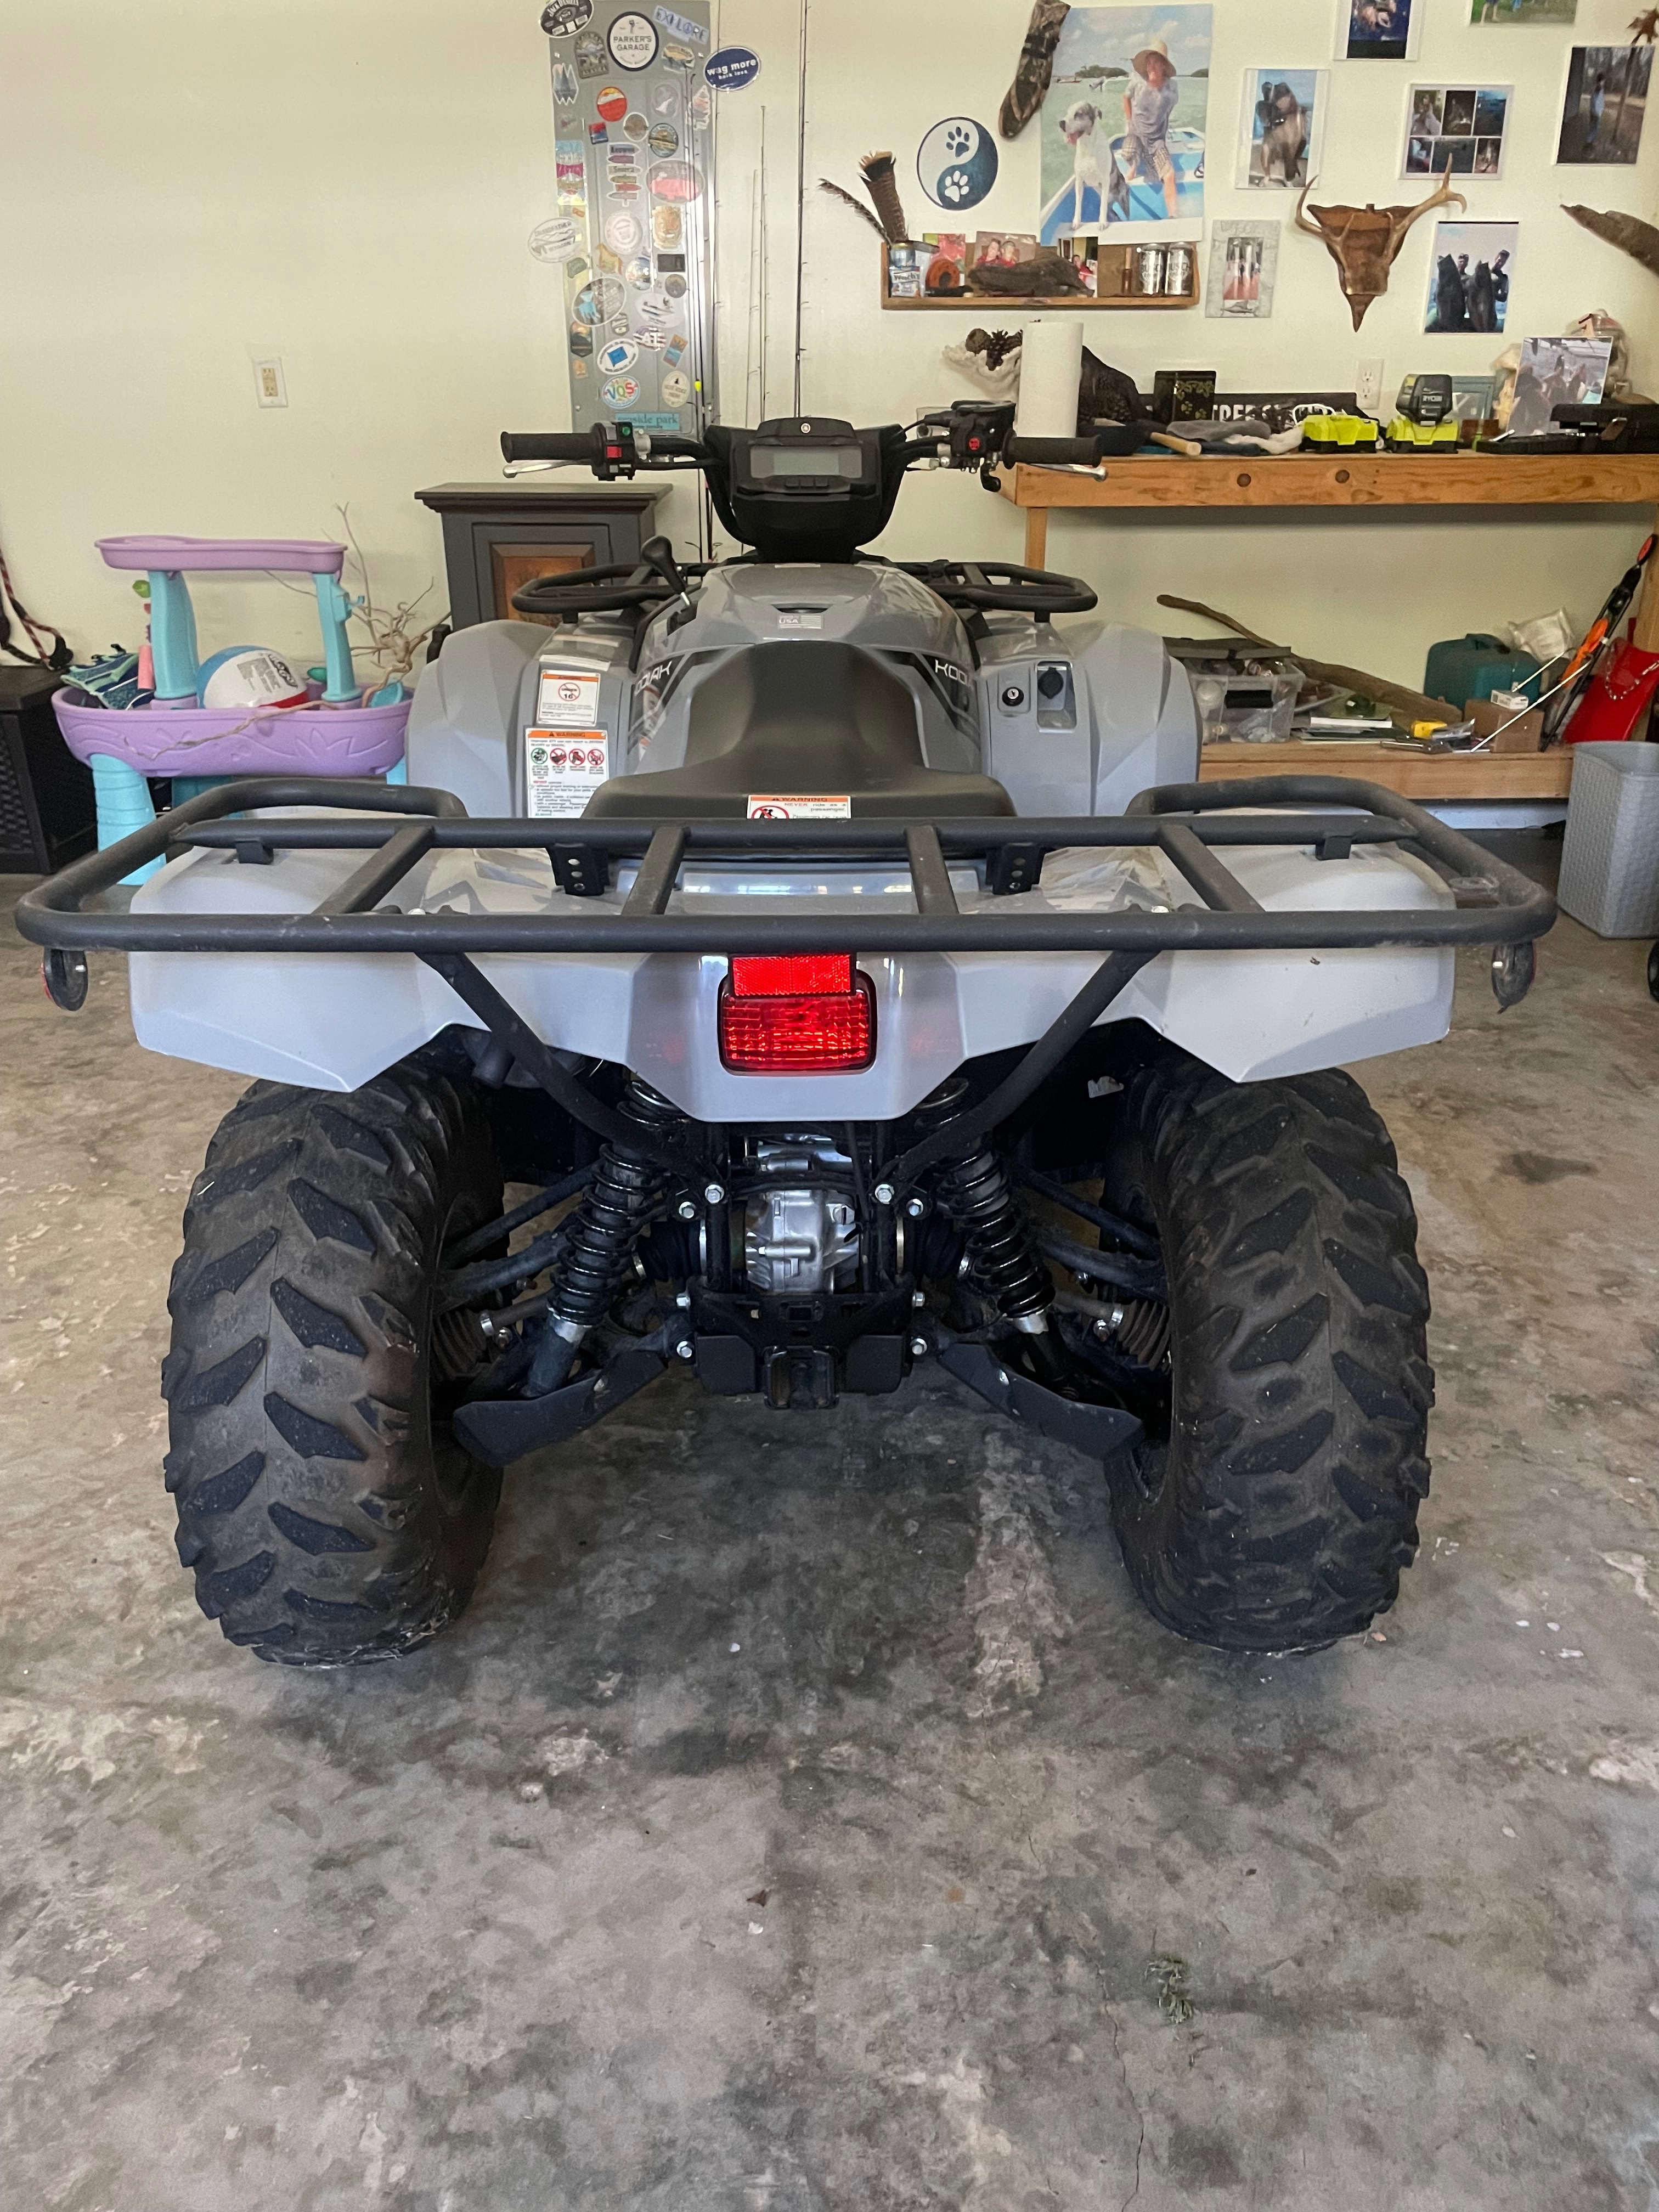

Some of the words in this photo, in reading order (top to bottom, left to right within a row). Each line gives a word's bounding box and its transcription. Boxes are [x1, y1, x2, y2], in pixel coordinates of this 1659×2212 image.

[707, 65, 728, 76] wag
[731, 59, 757, 71] more
[607, 381, 635, 399] VQS
[657, 414, 678, 426] park
